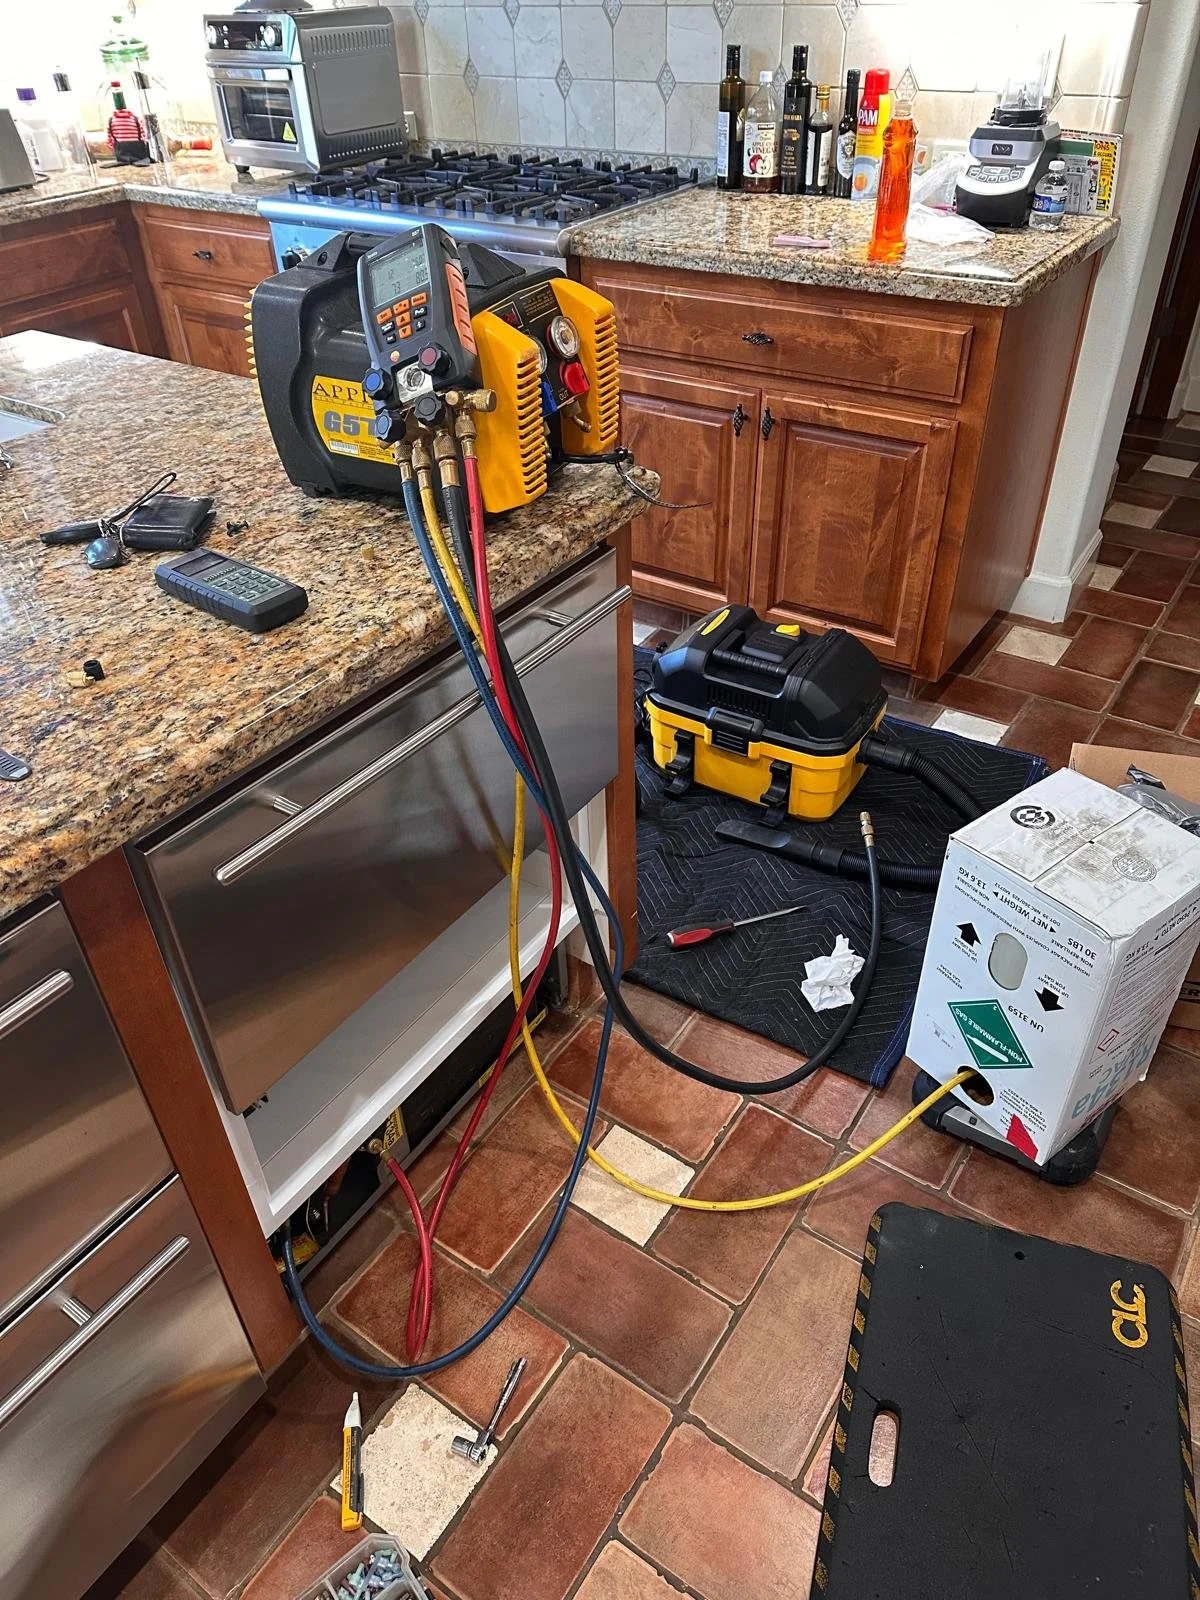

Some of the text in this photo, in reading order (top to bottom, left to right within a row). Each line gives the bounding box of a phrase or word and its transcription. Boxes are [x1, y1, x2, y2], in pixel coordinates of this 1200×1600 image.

[859, 109, 878, 126] PAM
[313, 383, 369, 403] APPI
[323, 411, 376, 435] G5T
[958, 865, 986, 890] 13.6 KG
[999, 893, 1048, 930] NET WEIGHT
[1025, 933, 1049, 952] COMPLIES
[1066, 936, 1096, 960] 30 LBS
[1050, 949, 1072, 967] PACKAGE
[1037, 975, 1069, 998] UP THIS WAY
[1043, 973, 1065, 990] FOR GAS
[954, 1007, 967, 1021] GAS
[1007, 1003, 1044, 1033] UN 3159
[967, 1017, 1022, 1063] NON-FLAMMABLE
[1110, 1279, 1149, 1349] CLC
